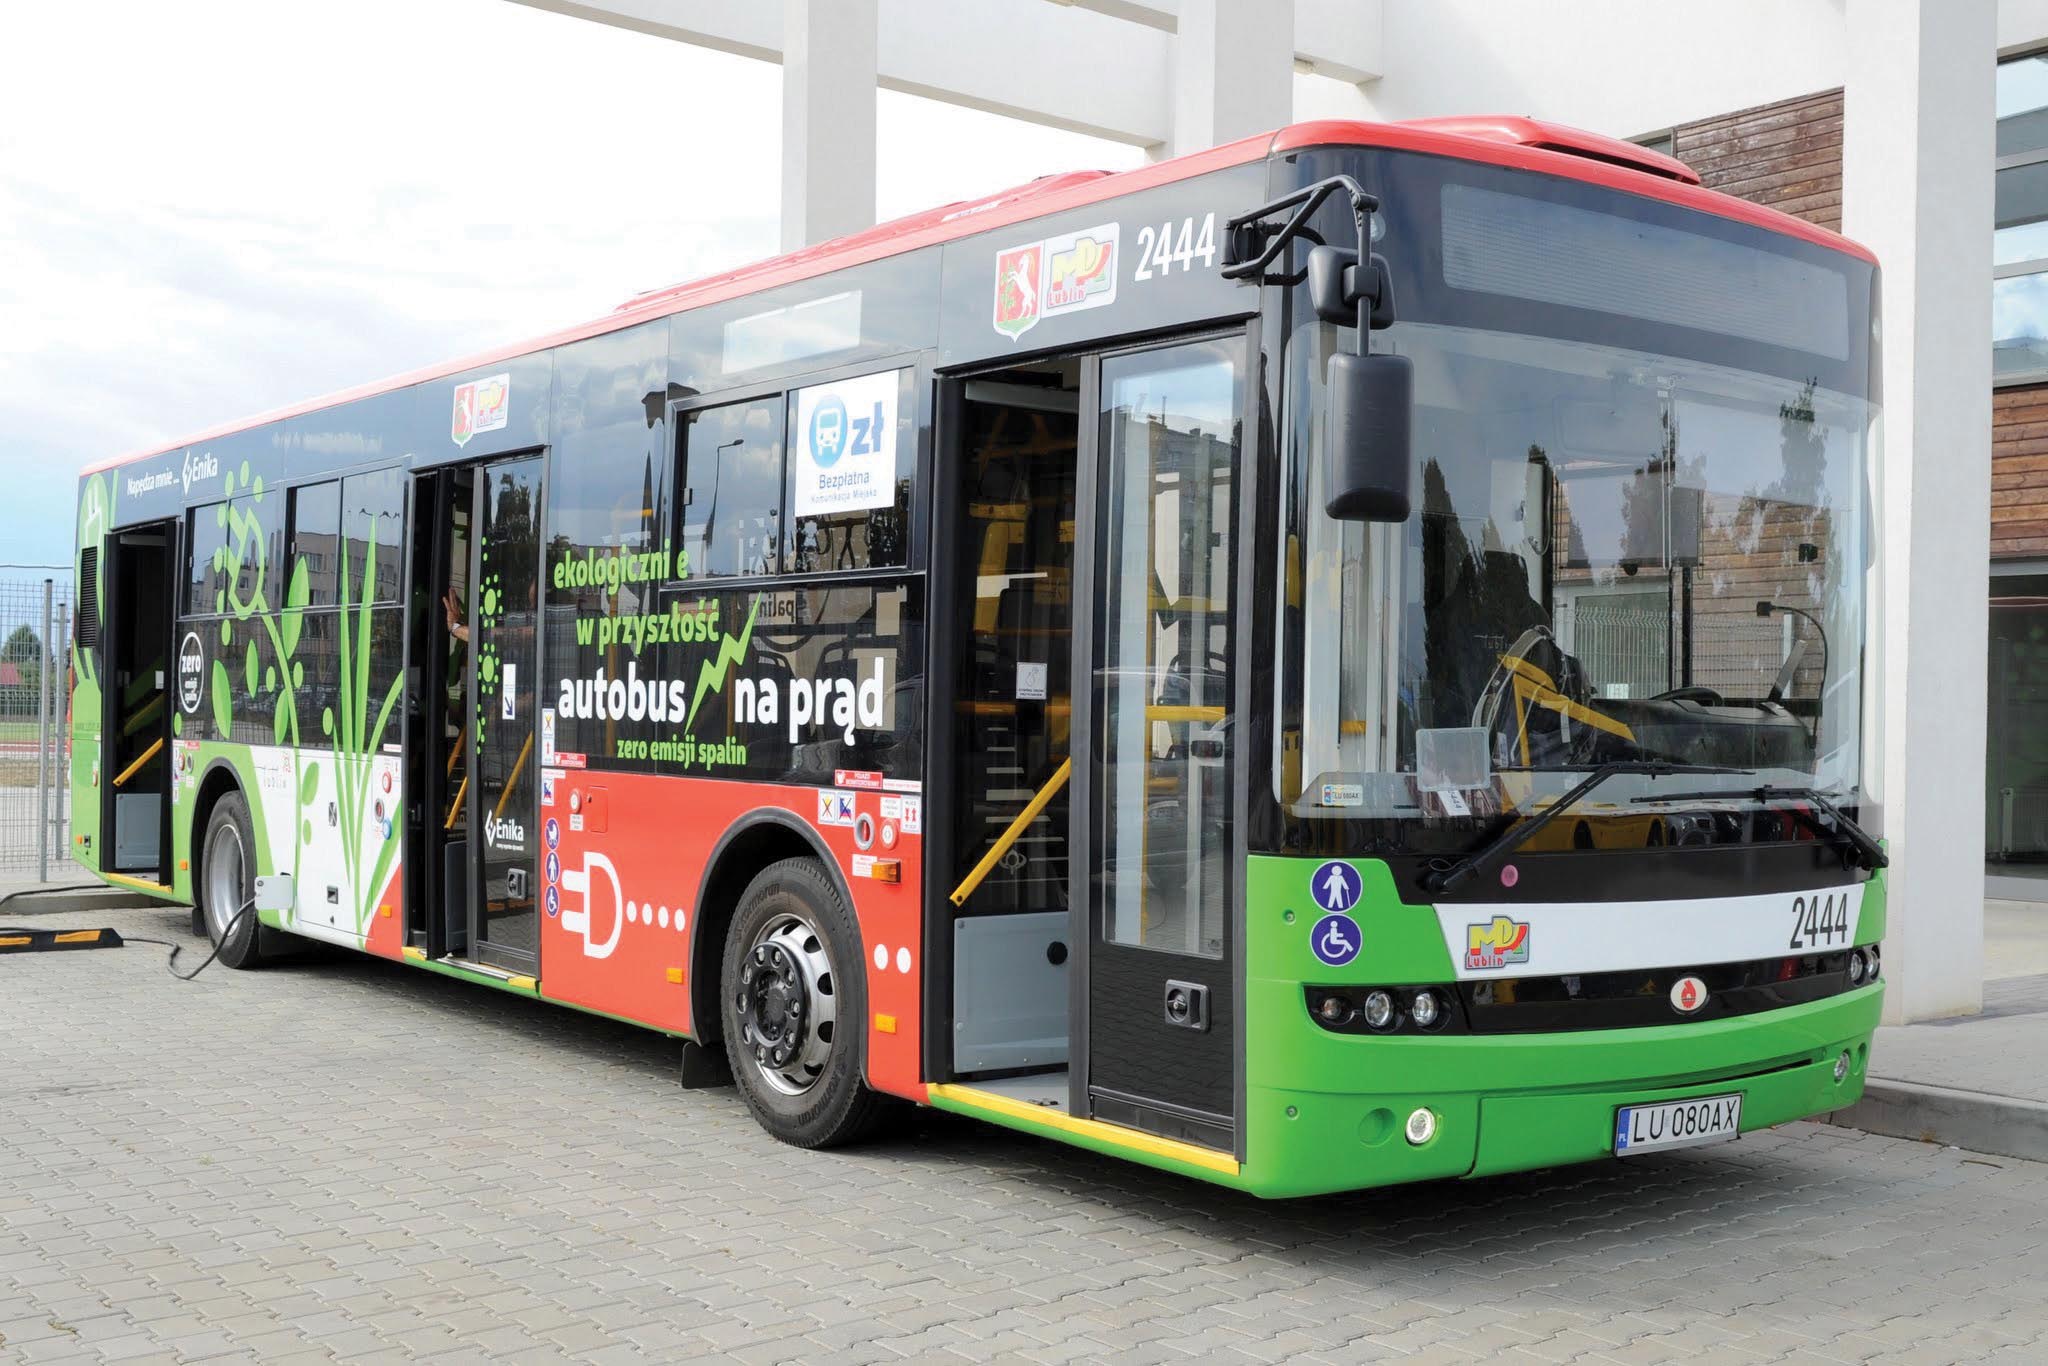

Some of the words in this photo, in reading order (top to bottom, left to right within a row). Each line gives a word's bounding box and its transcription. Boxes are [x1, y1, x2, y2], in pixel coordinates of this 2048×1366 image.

[1135, 212, 1216, 281] 2444
[850, 400, 884, 456] zł
[192, 452, 218, 482] Enika
[819, 471, 870, 490] Bezpłatna
[576, 618, 595, 645] w
[599, 598, 719, 656] przyszłość
[181, 655, 201, 673] zero
[558, 661, 686, 724] autobus
[734, 678, 778, 724] na
[789, 657, 883, 746] prąd
[617, 738, 648, 760] zero
[650, 734, 696, 770] emisji
[698, 736, 747, 771] spalin
[496, 817, 524, 842] Enika
[1790, 893, 1847, 949] 2444
[1467, 955, 1504, 968] Lublin
[1633, 1109, 1665, 1142] LU
[1672, 1100, 1737, 1137] 080AX
